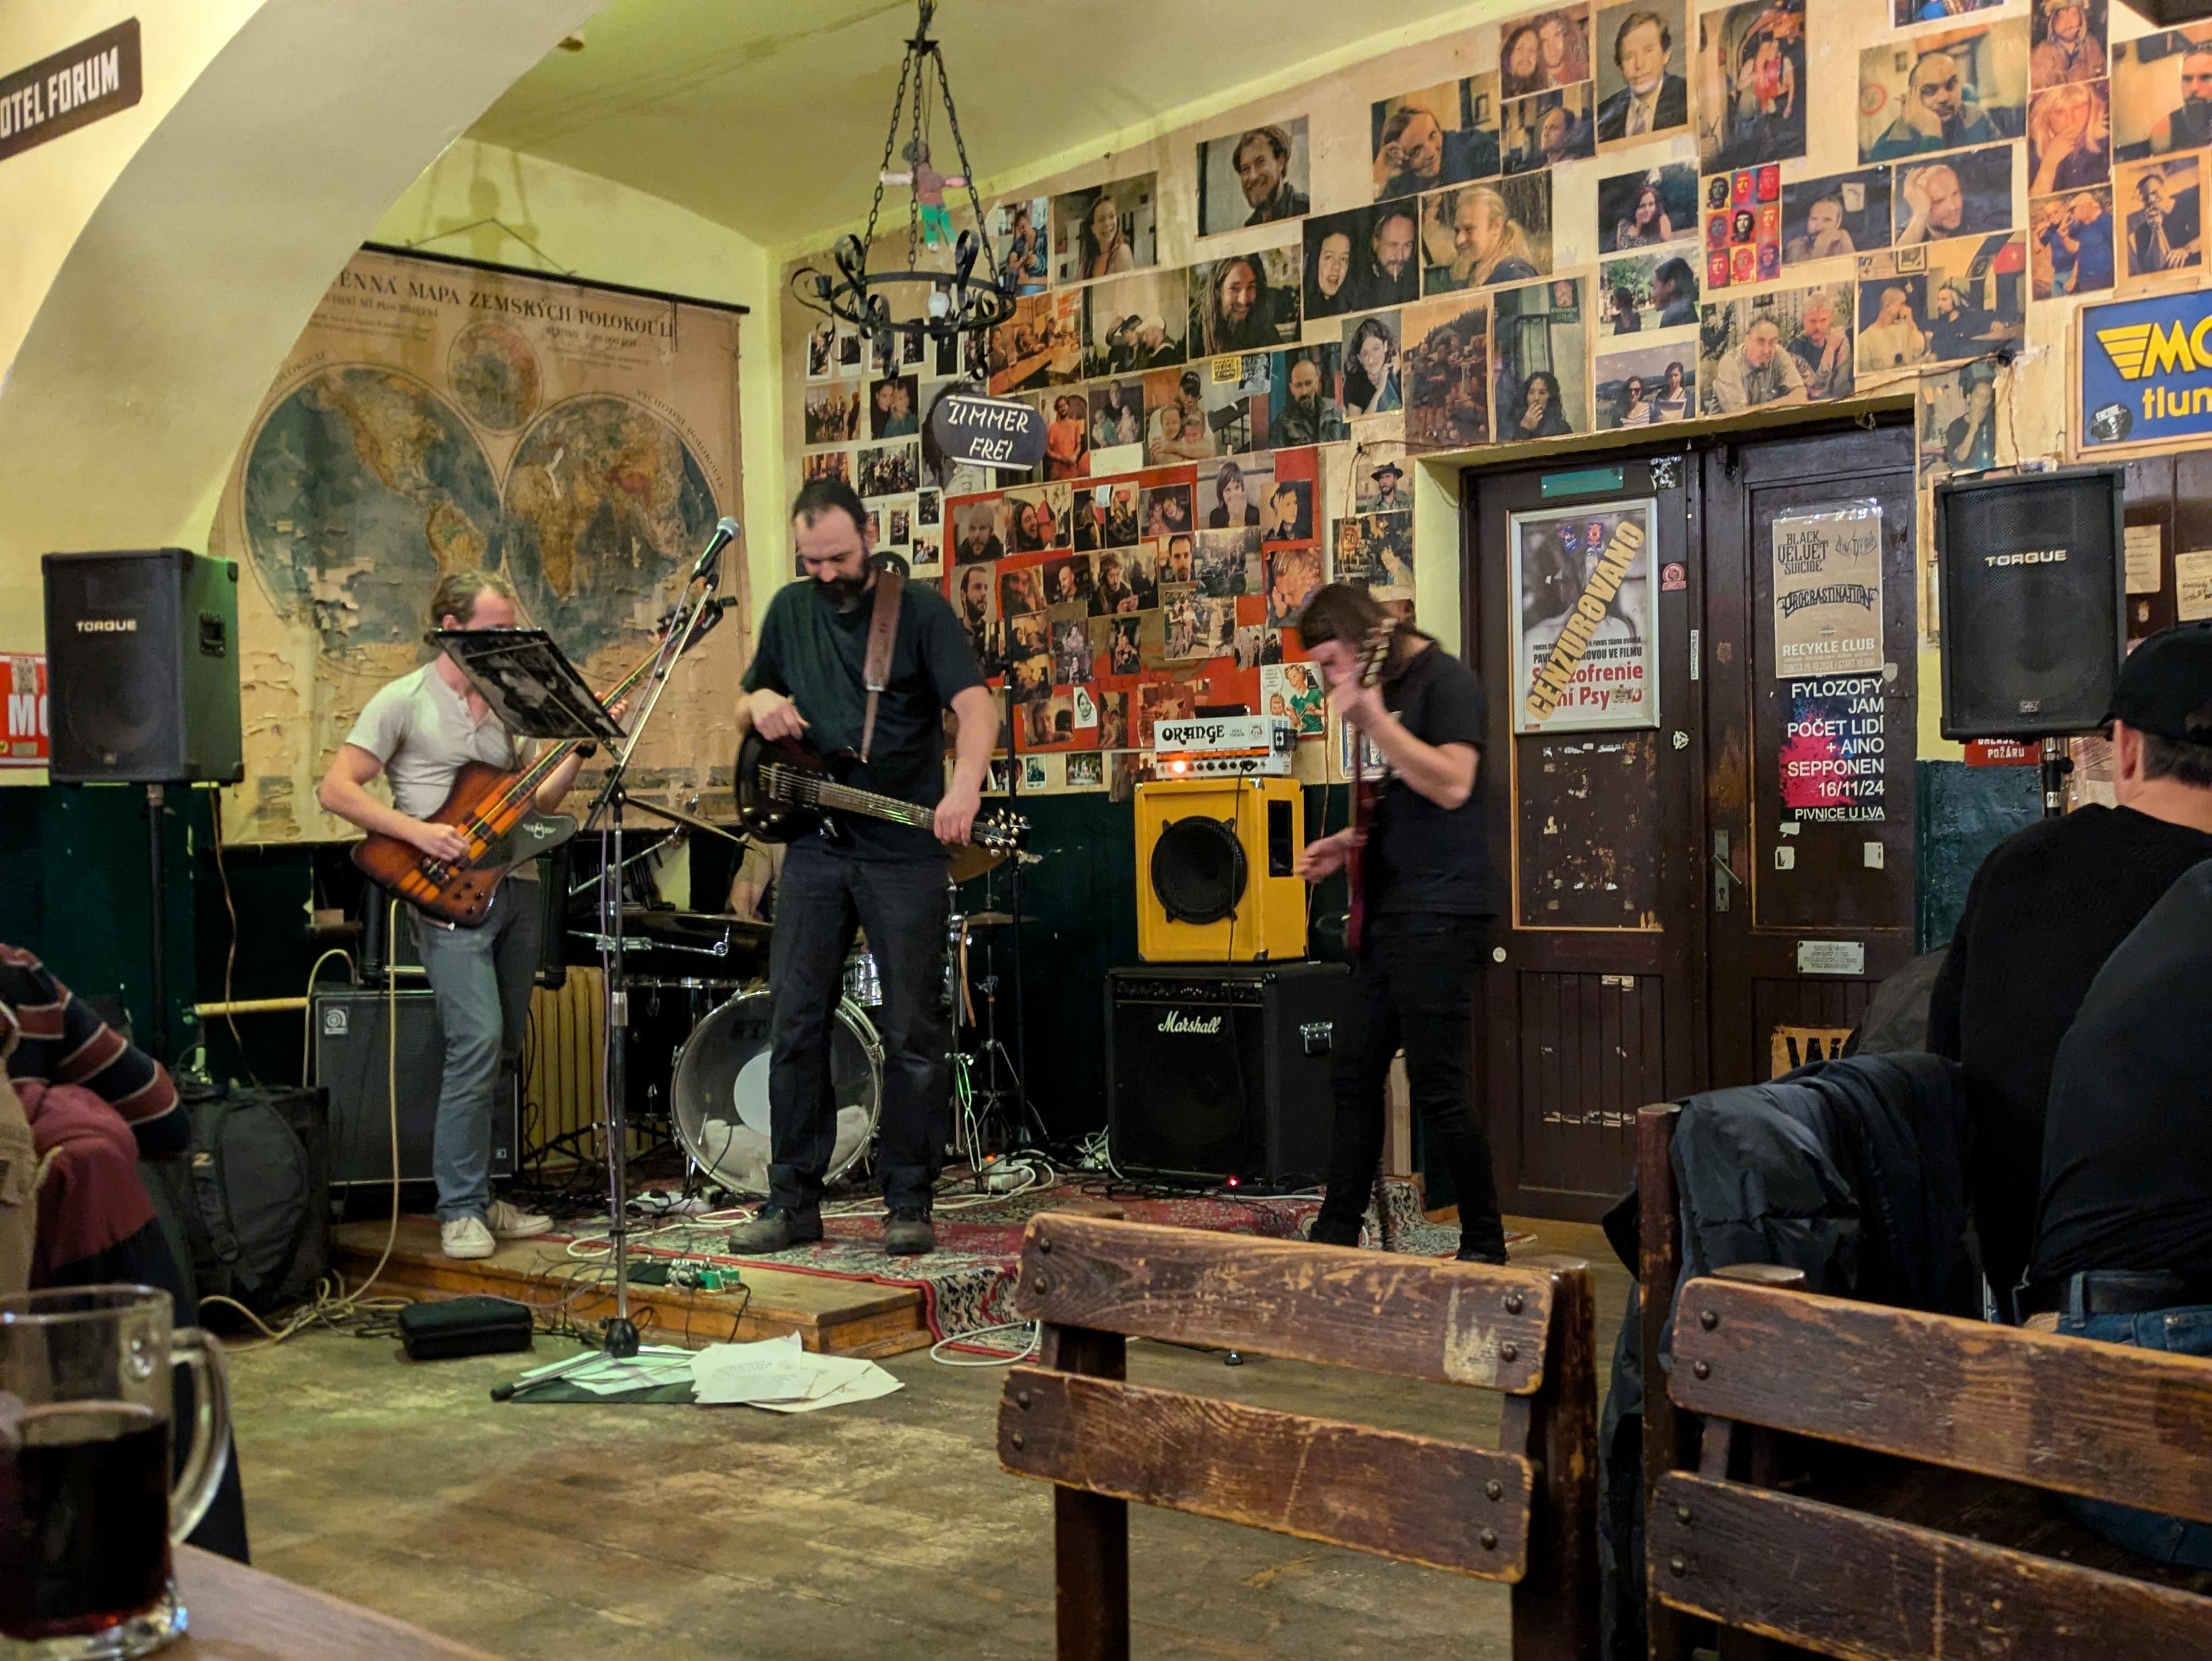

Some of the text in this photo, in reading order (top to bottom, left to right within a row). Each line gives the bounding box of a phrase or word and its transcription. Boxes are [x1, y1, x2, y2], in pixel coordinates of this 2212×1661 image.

[48, 45, 120, 119] FORUM
[336, 269, 397, 295] ENNÁ
[409, 281, 461, 305] MAPA
[469, 291, 570, 322] ZEMSKÝCH
[947, 401, 1029, 434] ZIMMER
[969, 436, 1014, 461] FREI
[1786, 530, 1820, 545] BLACK
[1778, 540, 1829, 563] VELVET
[1985, 549, 2068, 568] TORQUE
[1784, 559, 1824, 575] SUICIDE
[1776, 584, 1879, 619] PROCRASTINATION
[76, 618, 138, 633] TORQUE
[1526, 521, 1645, 720] CENZUROVANO
[1608, 649, 1618, 658] VE
[1620, 646, 1642, 658] FILMU
[1783, 638, 1875, 657] RECYKLE CLUB
[1791, 678, 1883, 699] FYLOZOFY
[1848, 697, 1884, 714] JAM
[1162, 724, 1225, 745] ORANGE
[1787, 715, 1884, 738] POČET LIDÍ
[1840, 737, 1885, 755] AINO
[1987, 746, 2025, 759] POŽÁRU
[1787, 758, 1885, 778] SEPPONEN
[1818, 780, 1885, 797] 16/11/24
[1795, 807, 1845, 820] PIVNICE
[1849, 808, 1858, 819] U
[1862, 807, 1885, 820] LVA
[1157, 1010, 1222, 1035] Marshall
